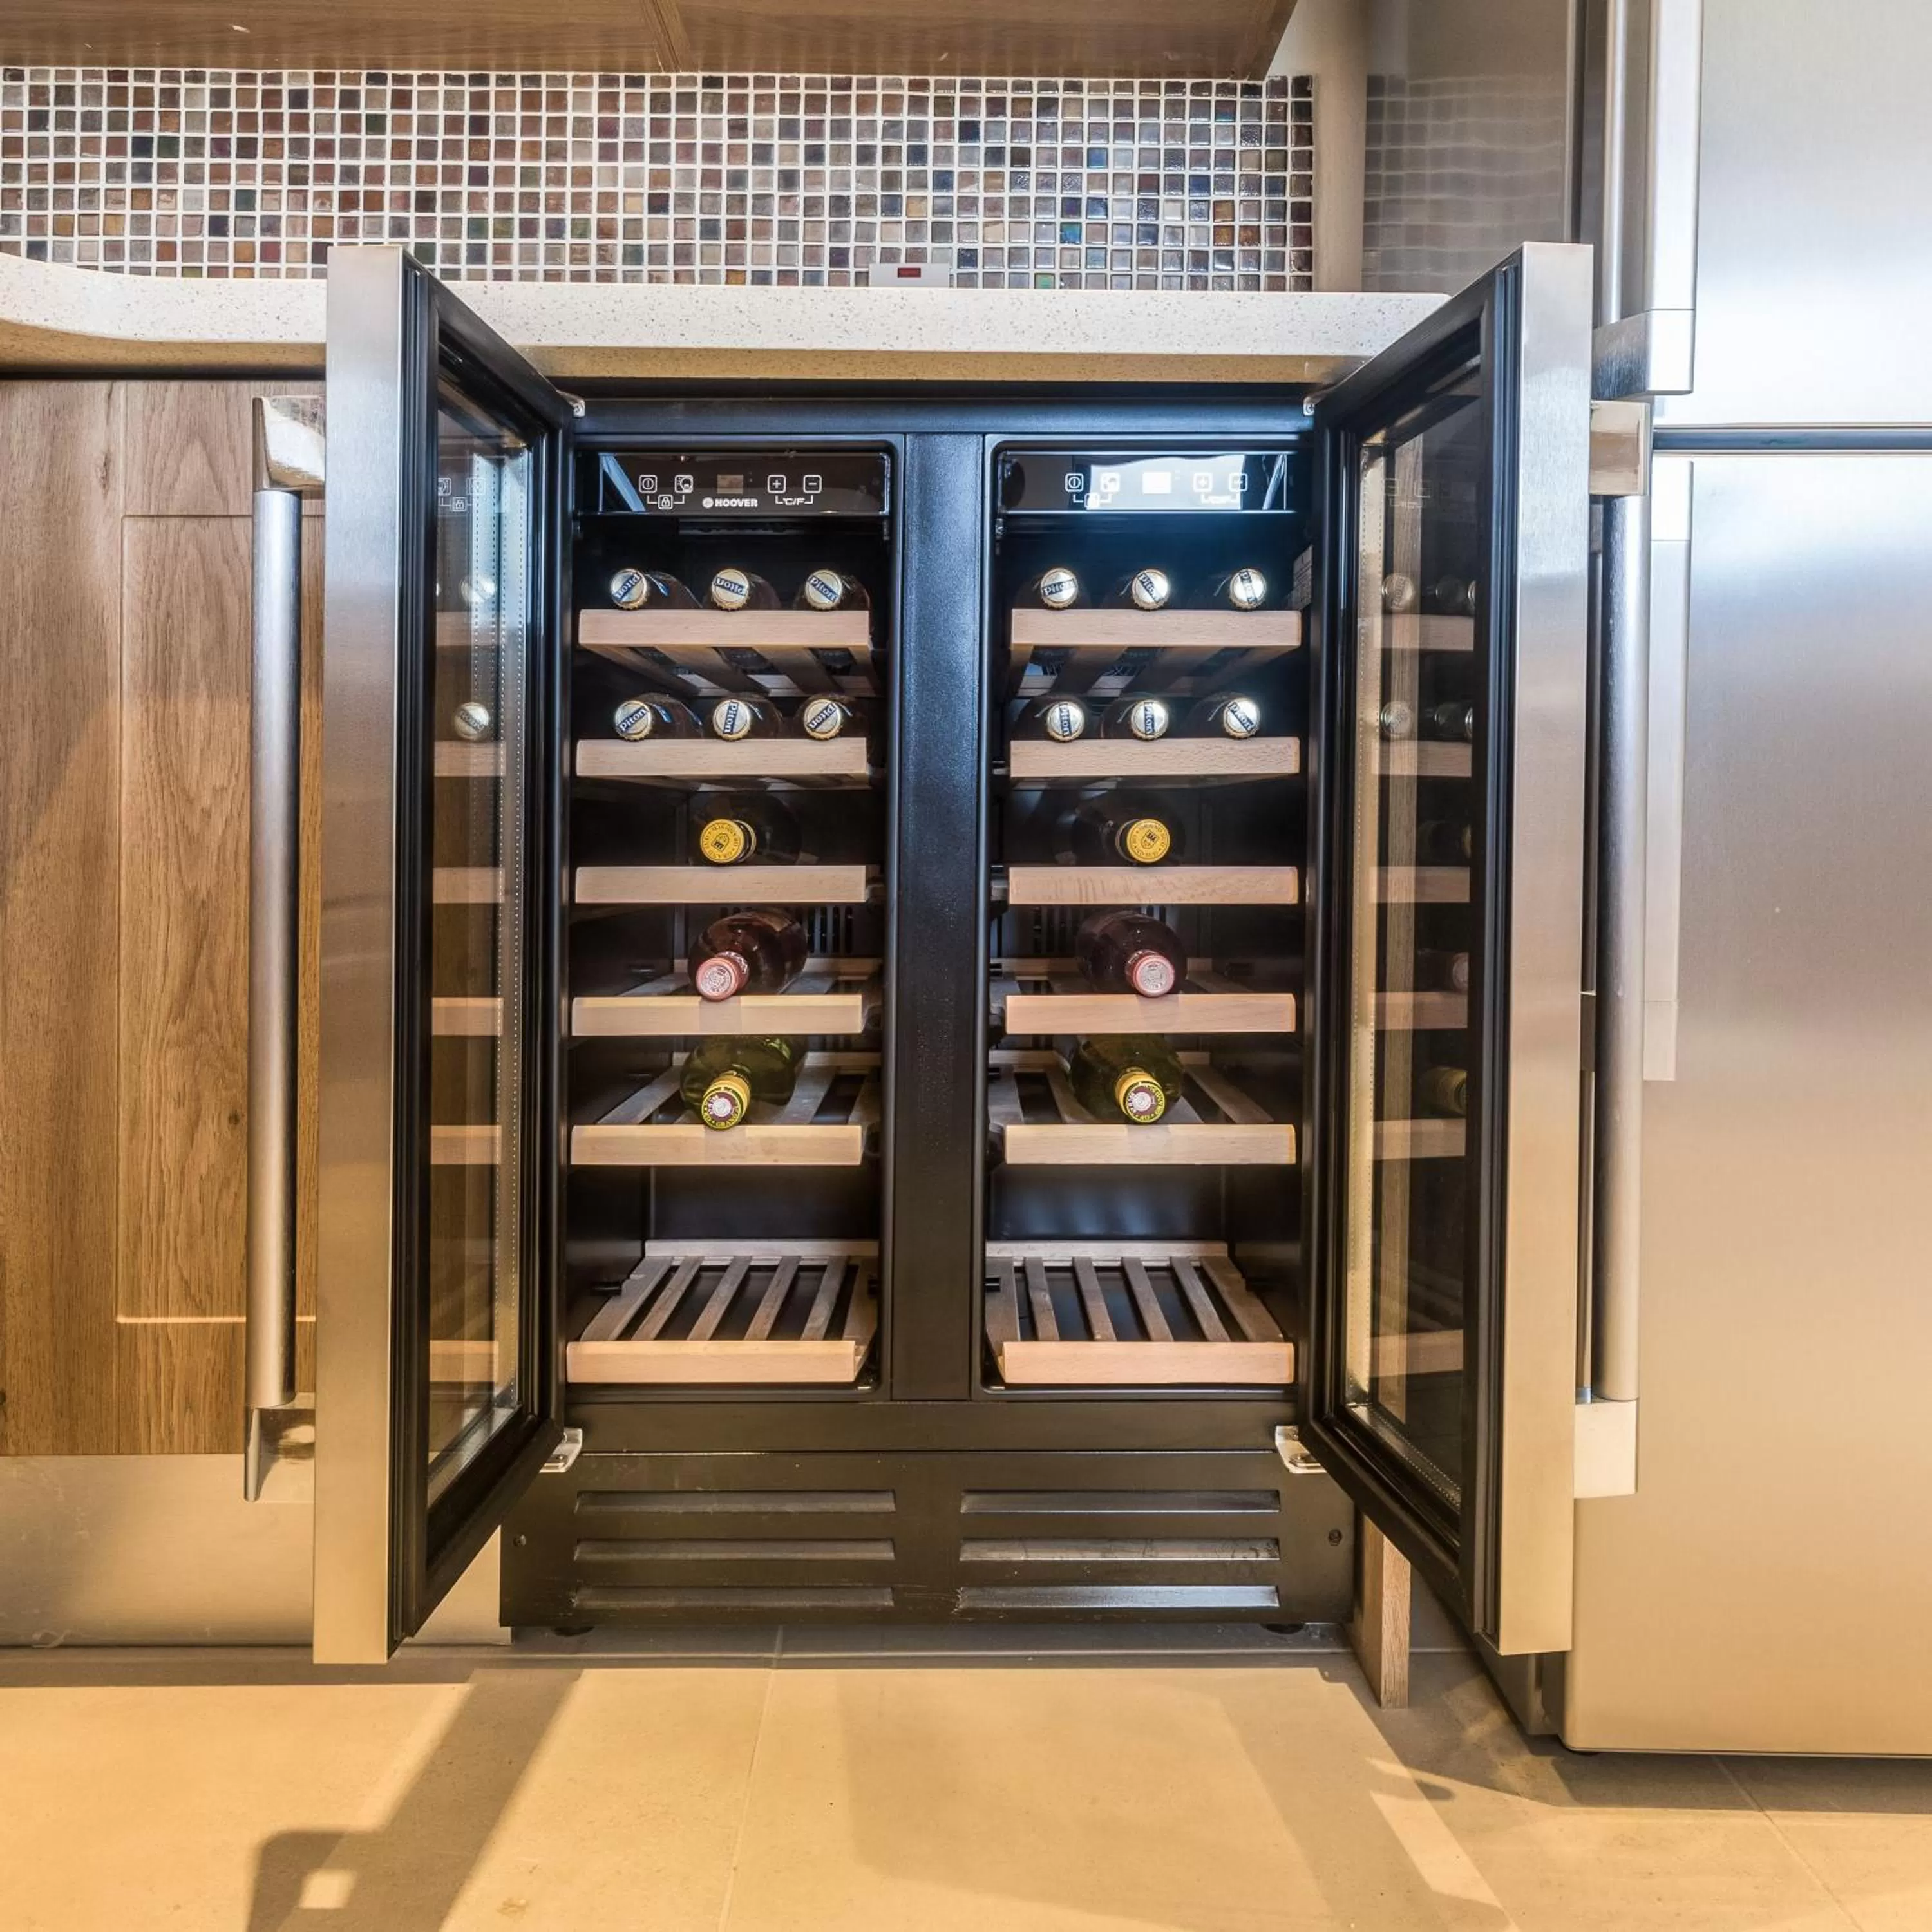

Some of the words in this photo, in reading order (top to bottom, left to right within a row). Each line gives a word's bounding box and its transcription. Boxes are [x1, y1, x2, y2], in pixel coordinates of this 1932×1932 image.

[715, 498, 758, 507] HOOVER
[615, 573, 641, 599] Piton
[716, 578, 744, 595] Piton
[810, 576, 838, 601] Piton
[1139, 573, 1162, 602] Pito
[619, 708, 647, 731] Piton
[724, 701, 737, 733] Piton
[808, 703, 837, 729] Piton
